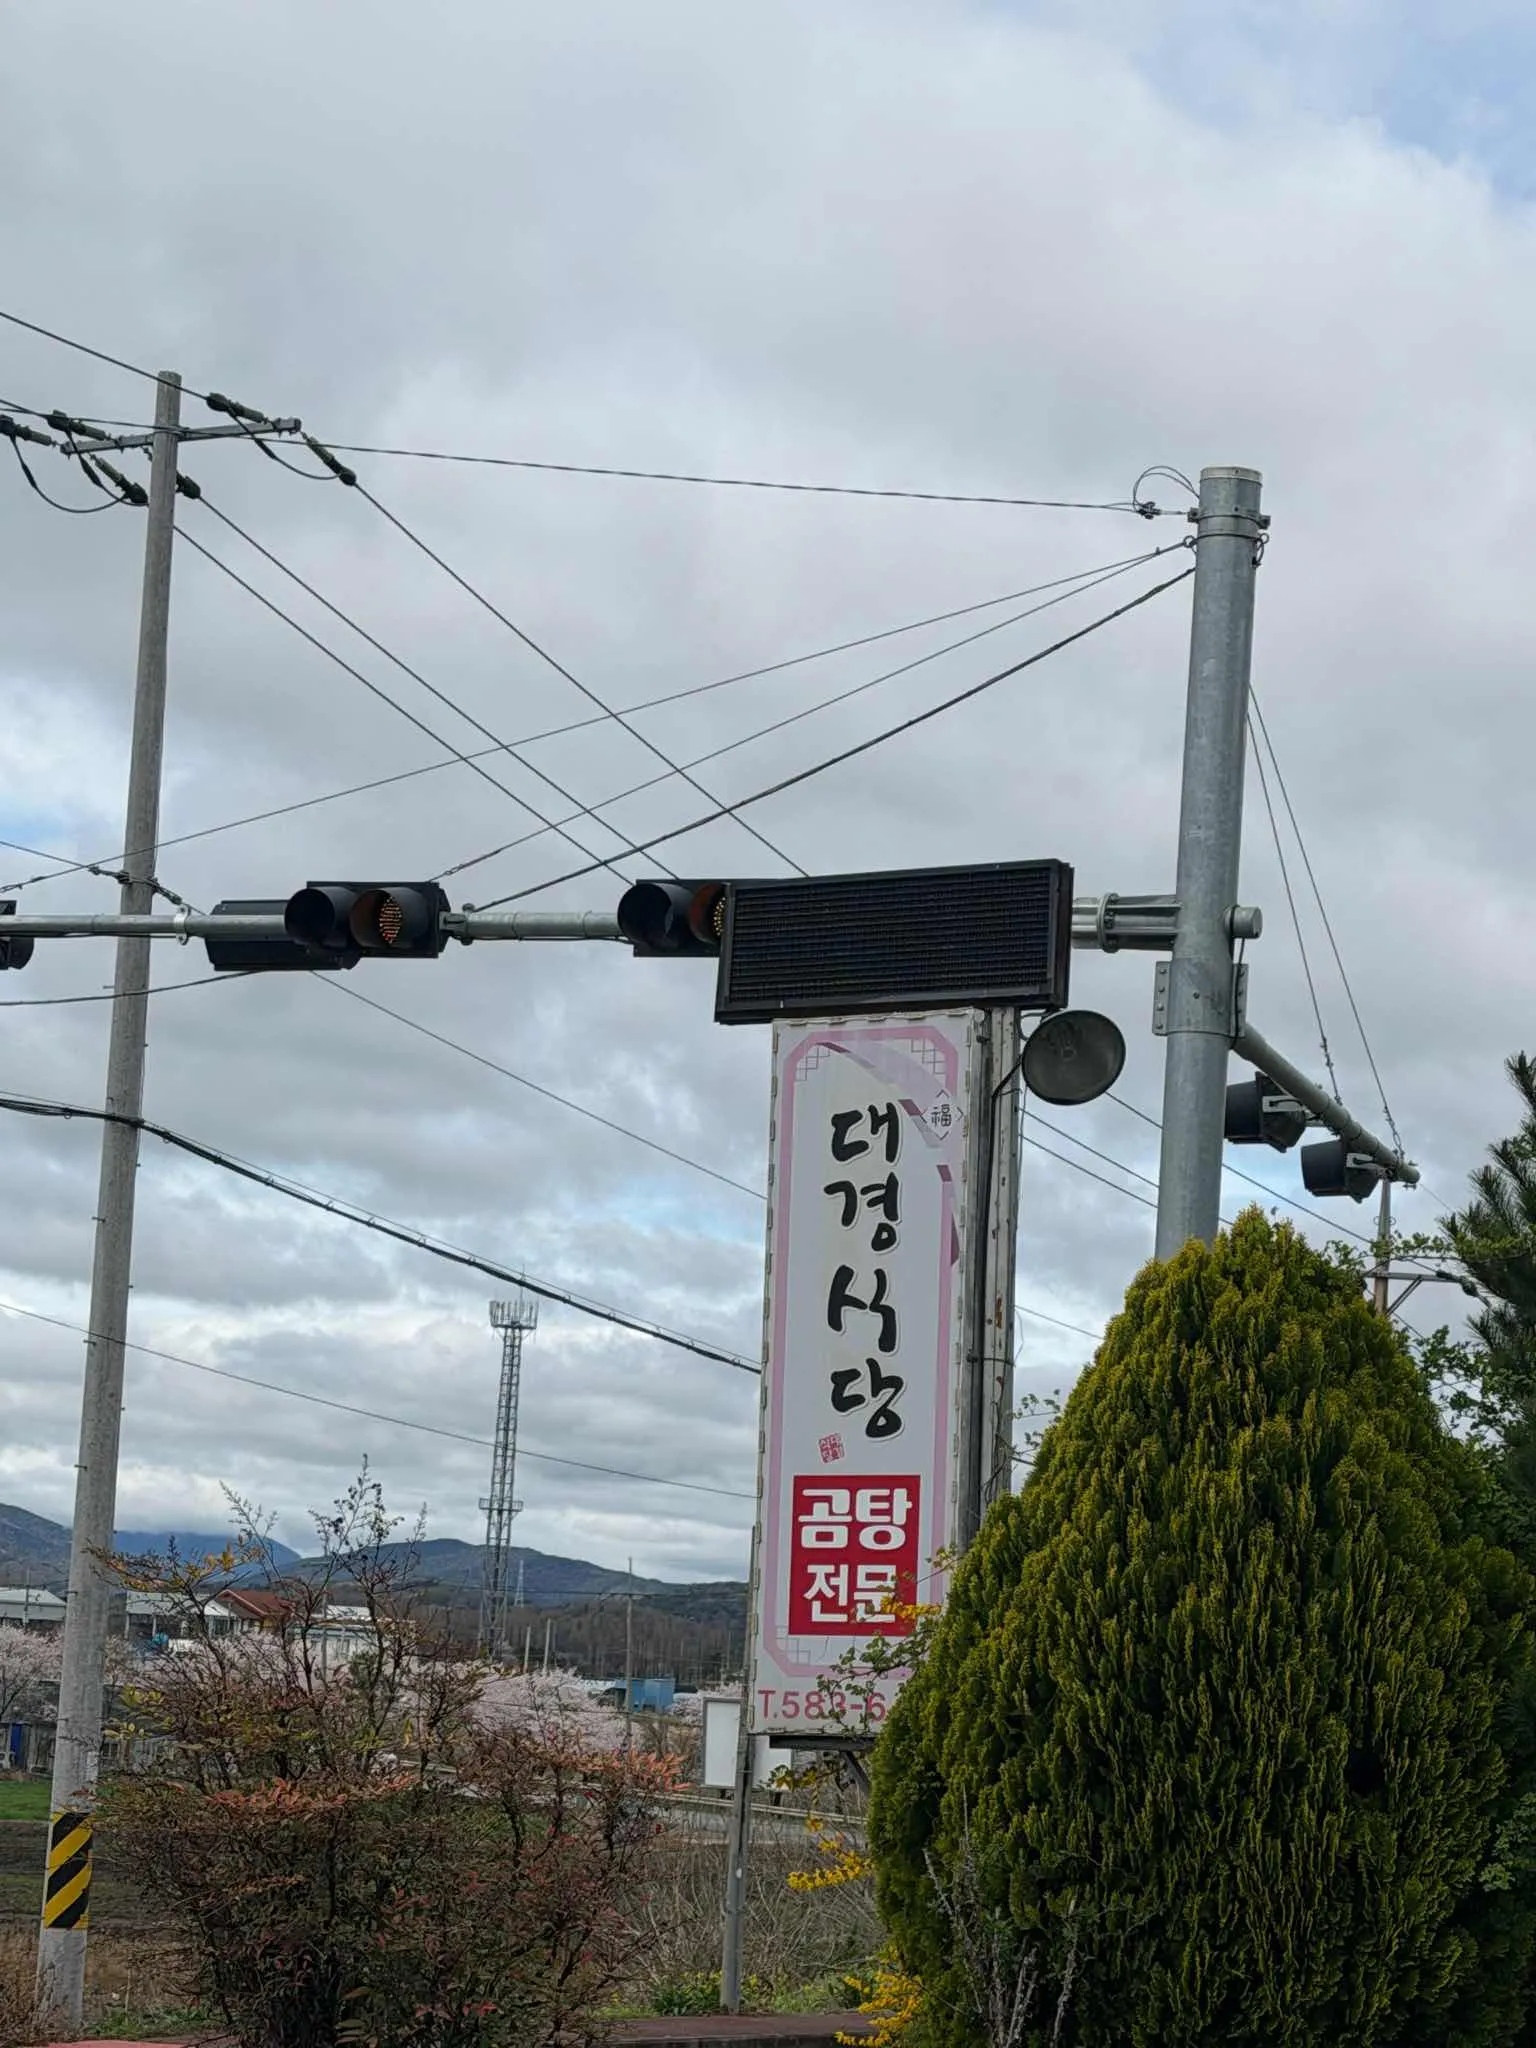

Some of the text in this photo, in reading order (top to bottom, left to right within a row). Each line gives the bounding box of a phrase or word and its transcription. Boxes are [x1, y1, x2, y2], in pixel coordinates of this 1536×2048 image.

[931, 1103, 952, 1127] 福
[824, 1101, 903, 1438] 대경식당
[798, 1488, 912, 1550] 곰탕
[803, 1564, 897, 1623] 전문
[757, 1689, 887, 1722] T.583-6
